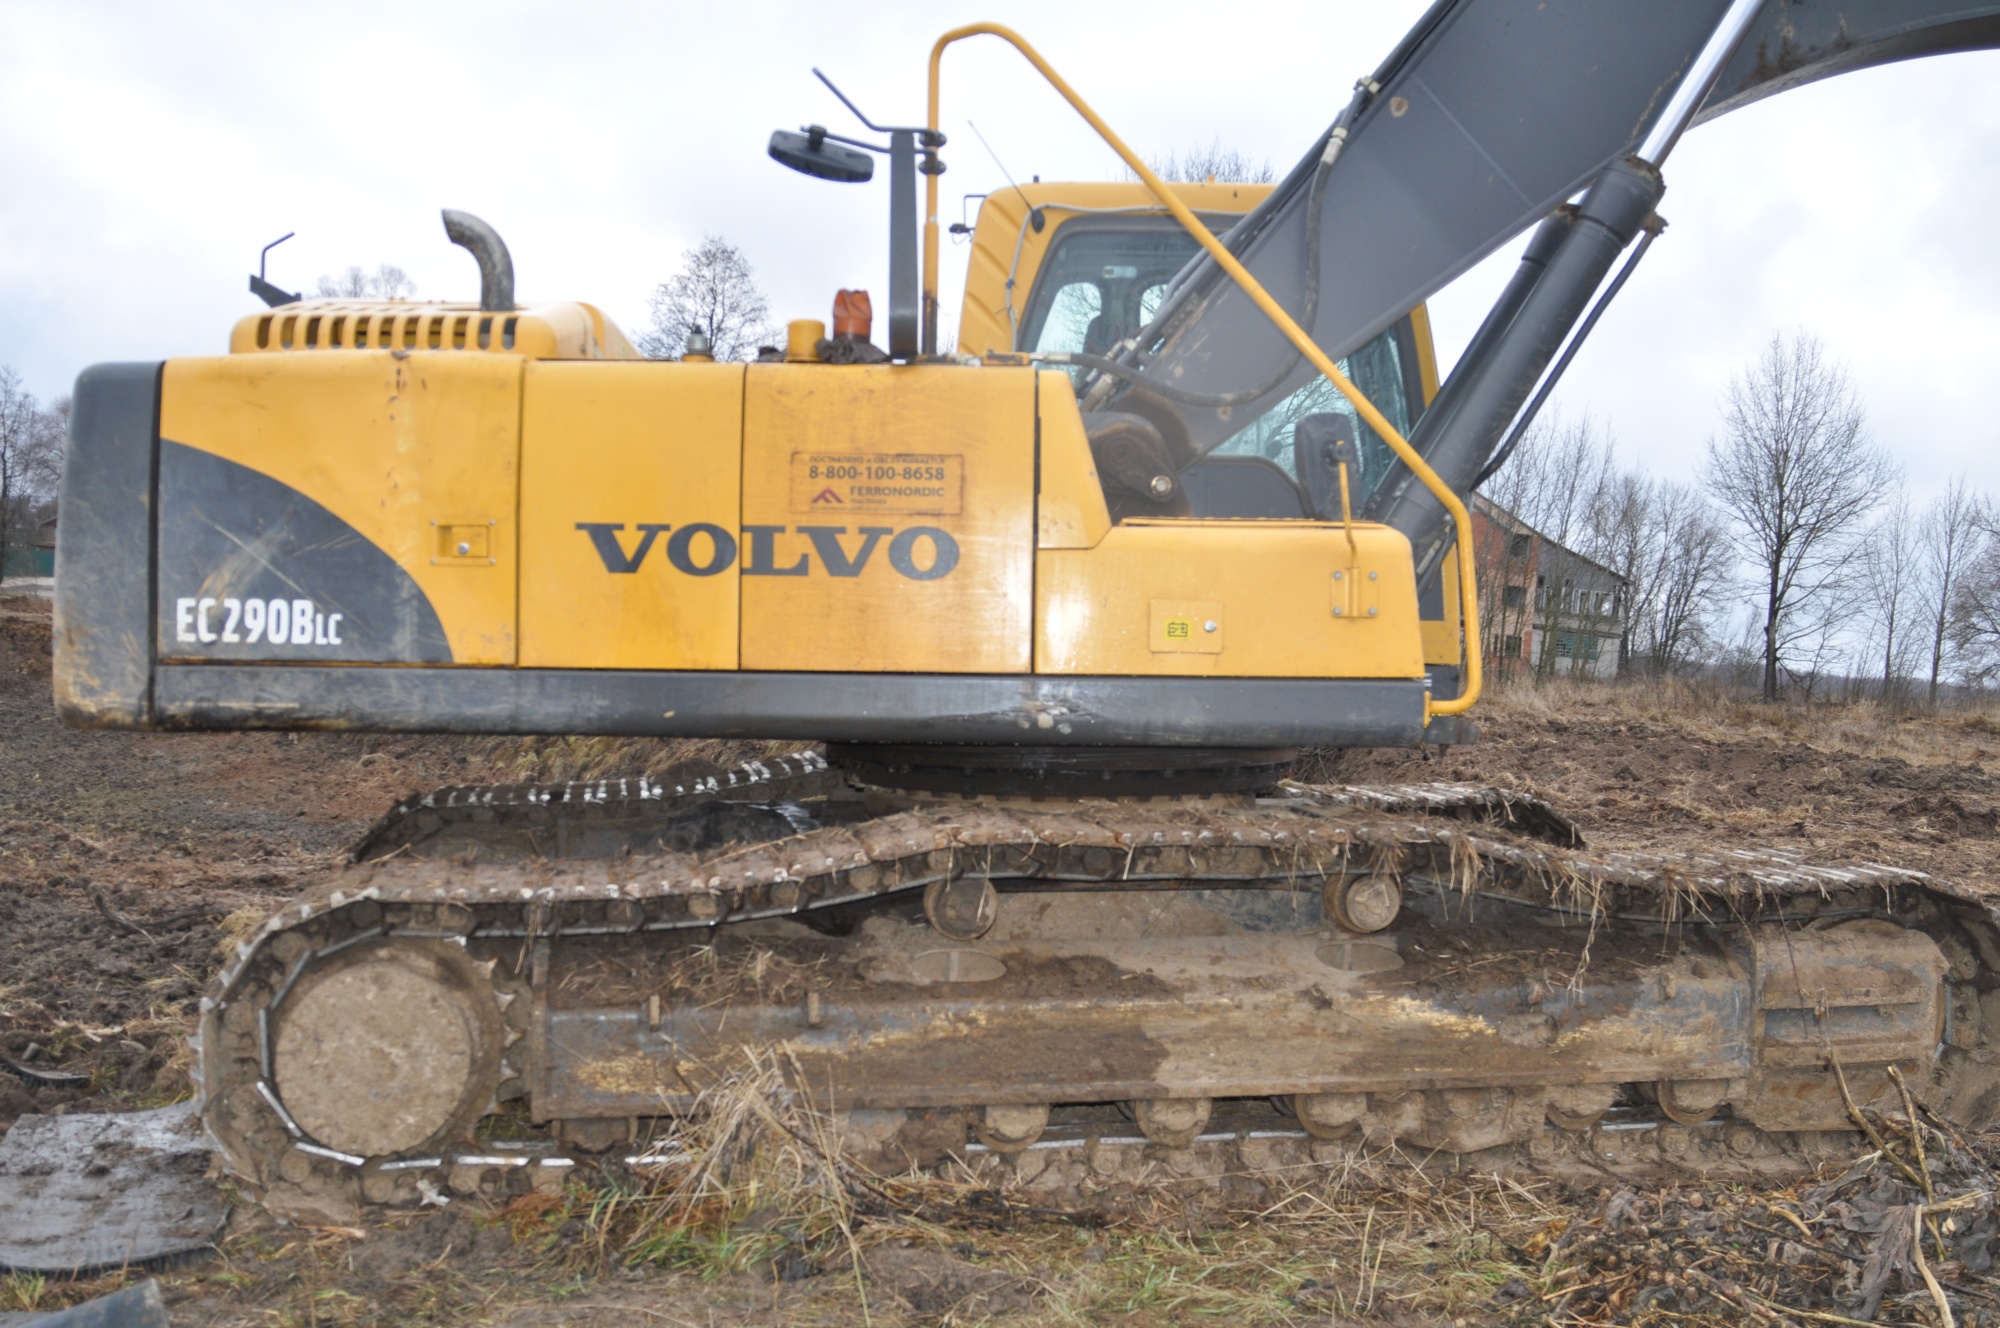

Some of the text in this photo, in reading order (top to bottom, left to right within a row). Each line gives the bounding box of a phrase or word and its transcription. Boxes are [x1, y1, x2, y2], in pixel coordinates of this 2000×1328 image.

[808, 465, 945, 480] 8-800-100-8658
[849, 485, 945, 497] FERRONORDIC
[575, 522, 960, 581] VOLVO
